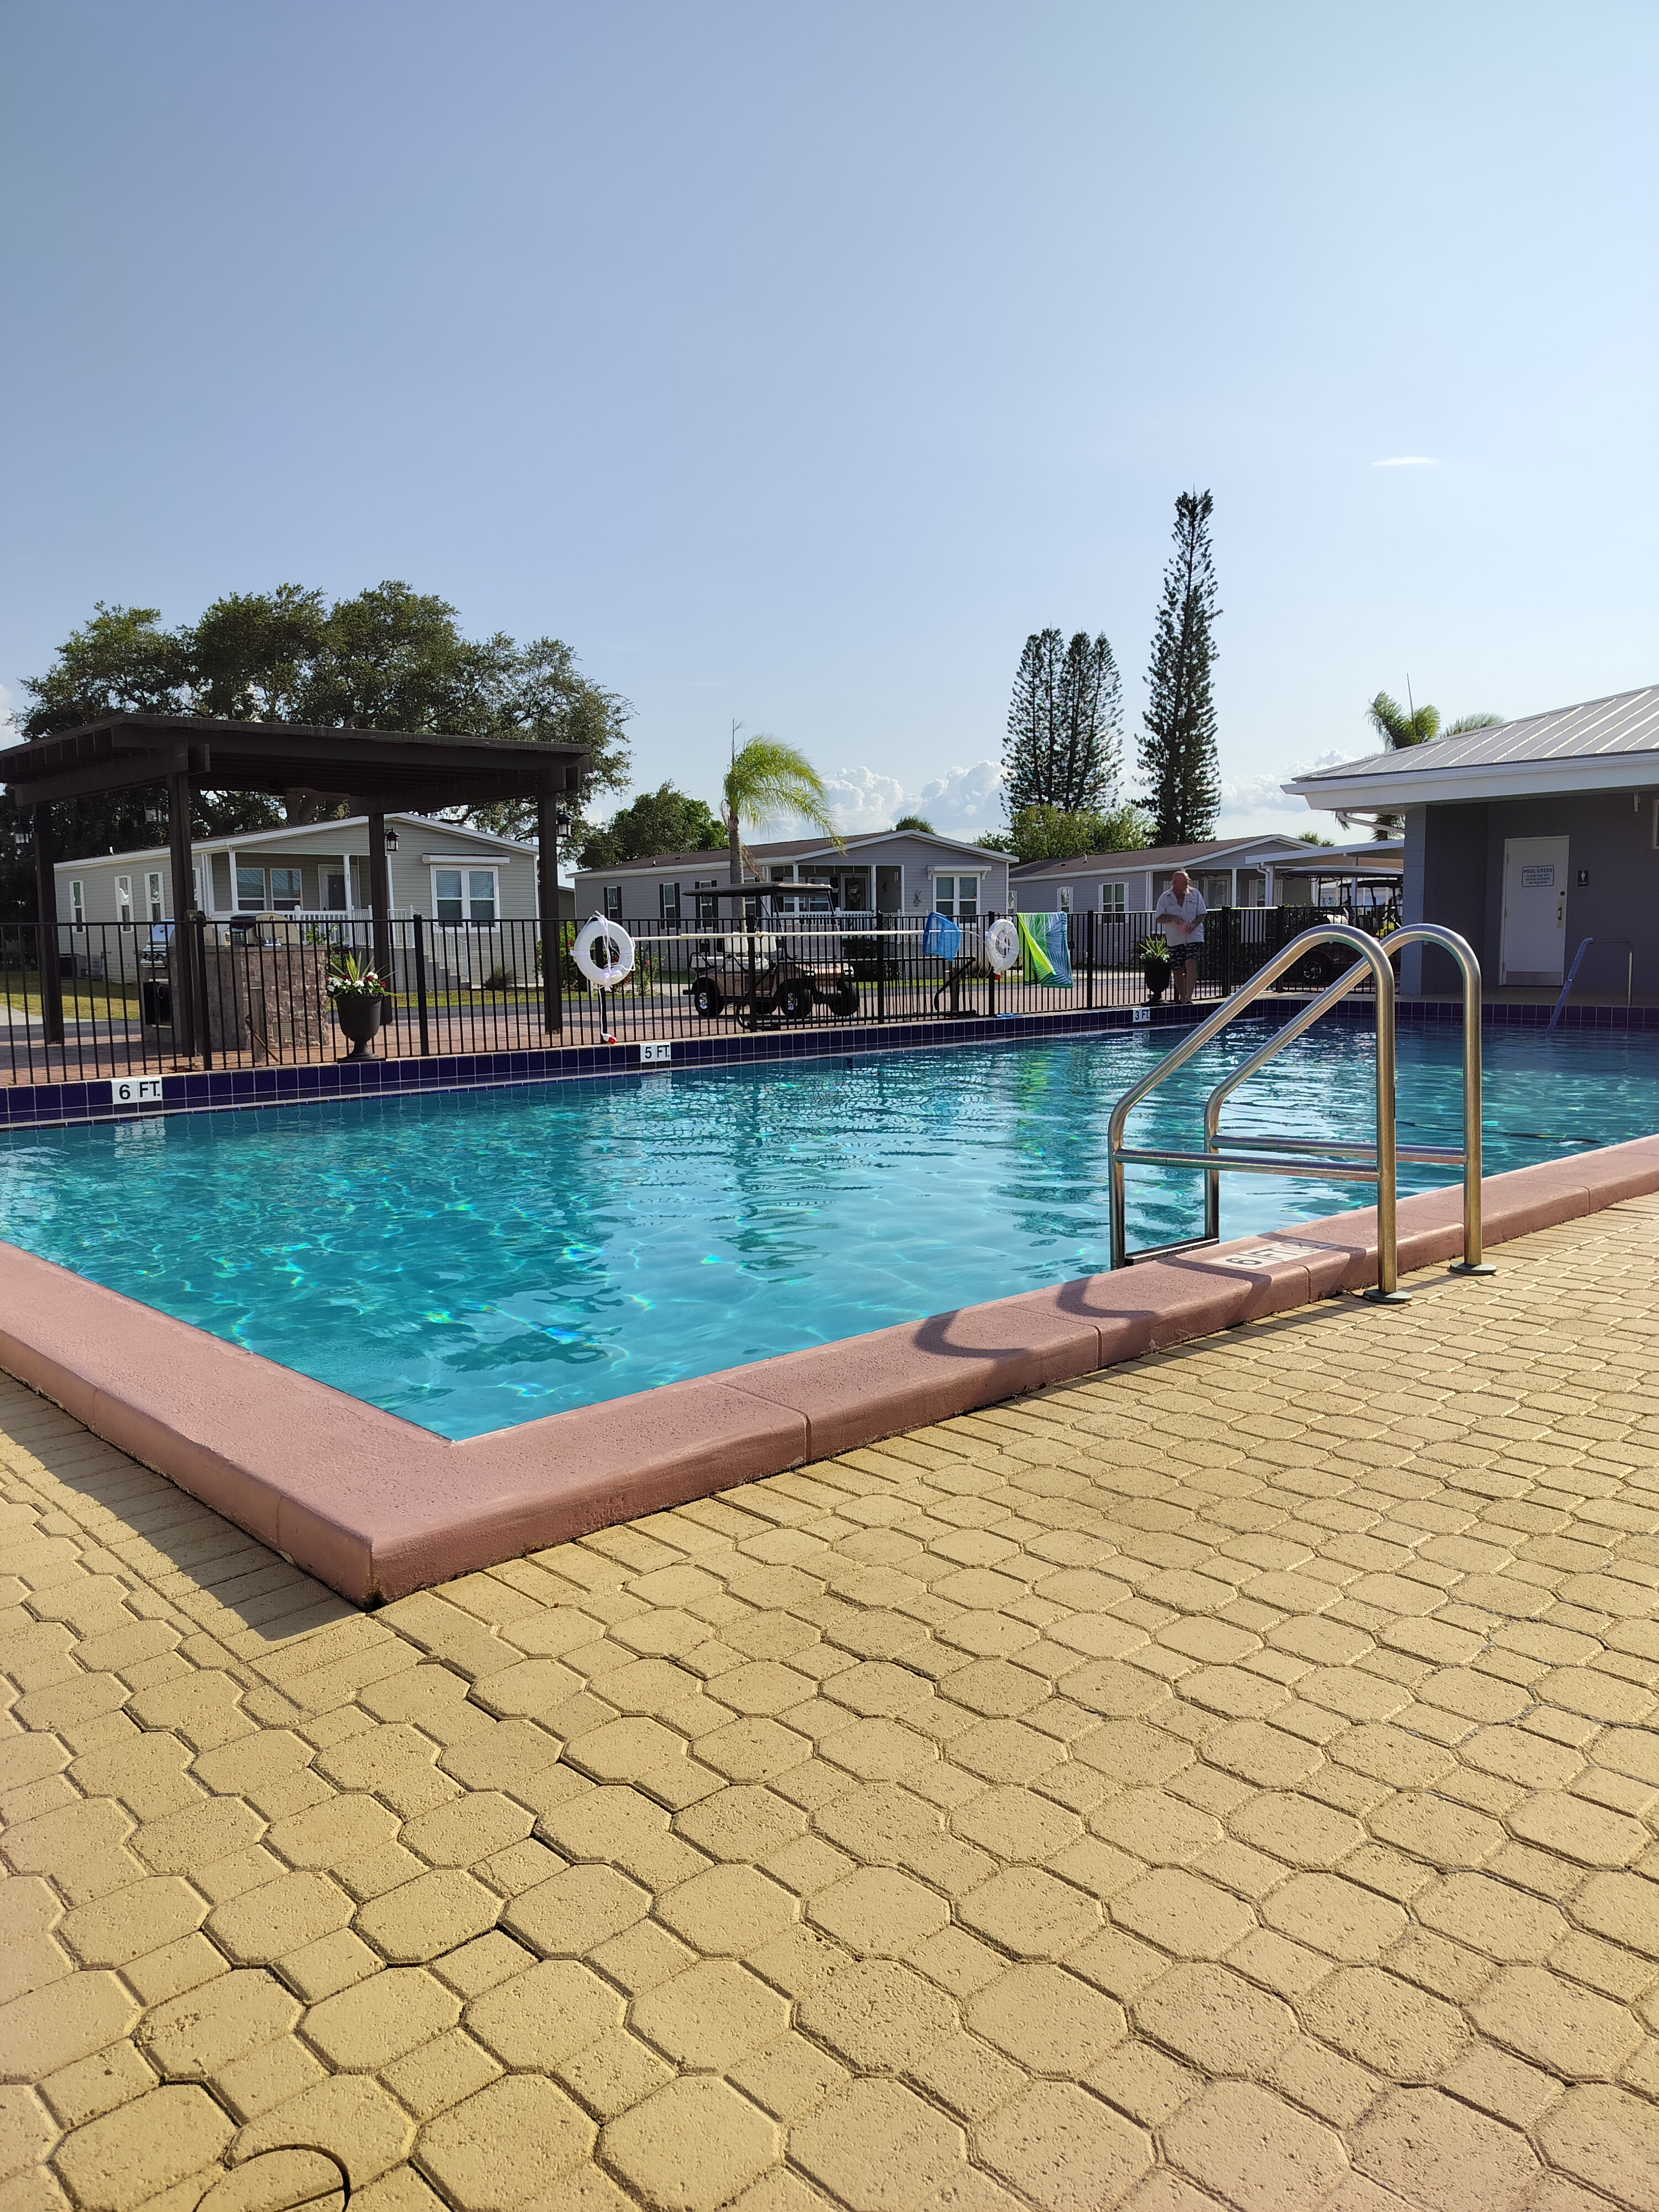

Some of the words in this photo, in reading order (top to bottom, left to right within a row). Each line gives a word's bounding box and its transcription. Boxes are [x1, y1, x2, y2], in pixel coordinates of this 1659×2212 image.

[1135, 1010, 1140, 1020] 3
[645, 1046, 652, 1059] 5
[657, 1045, 670, 1058] FT.
[119, 1084, 131, 1100] 6
[139, 1081, 160, 1098] FT.
